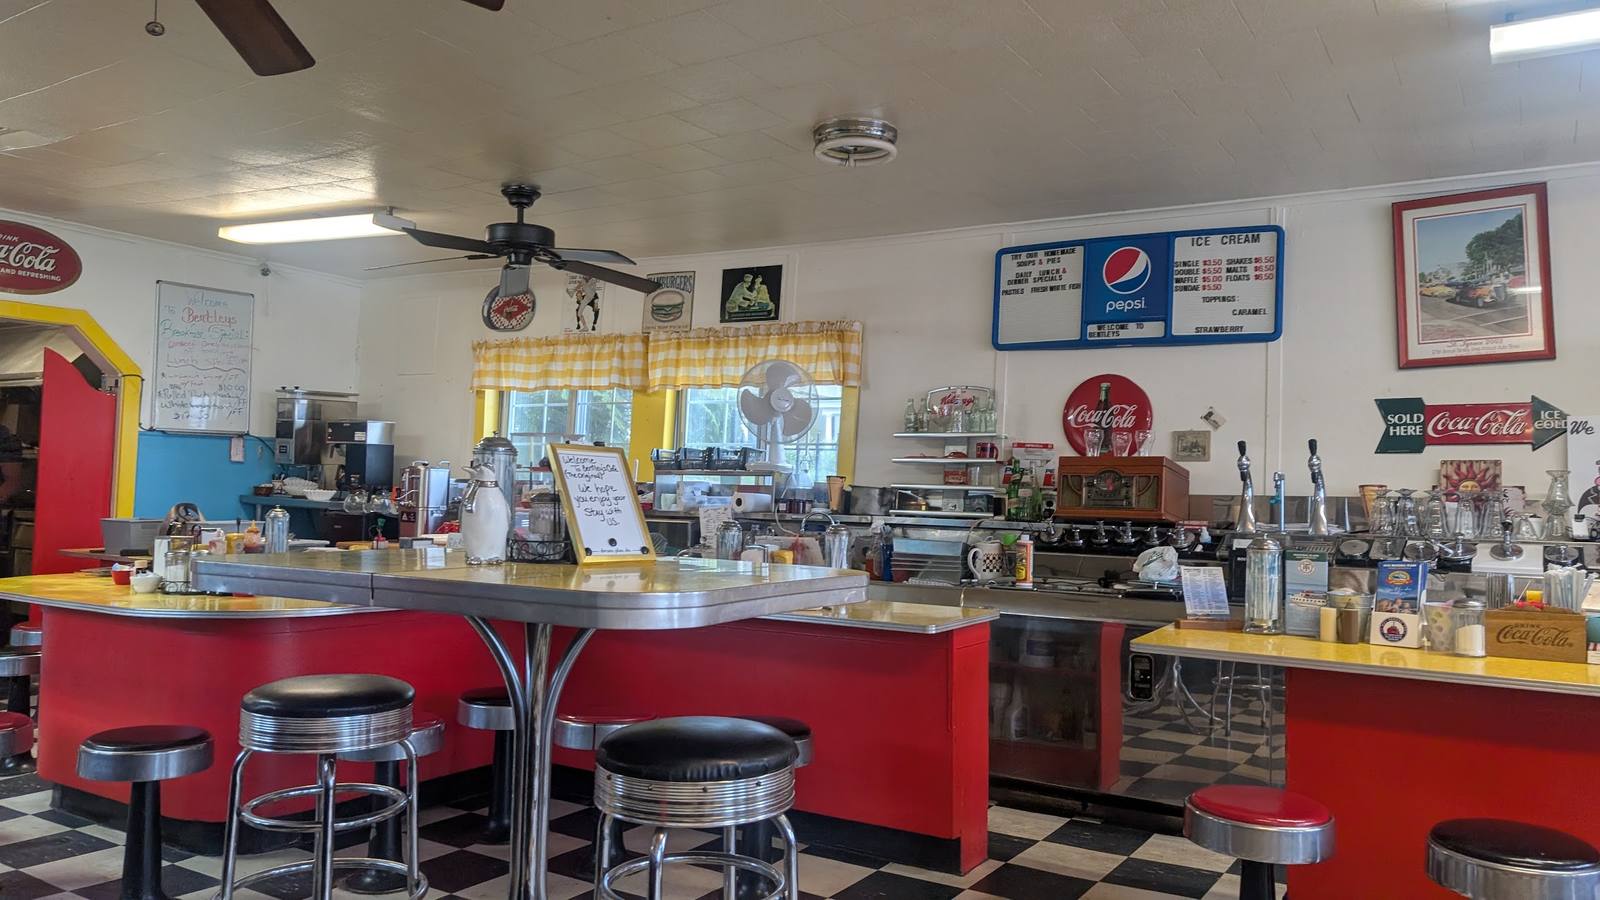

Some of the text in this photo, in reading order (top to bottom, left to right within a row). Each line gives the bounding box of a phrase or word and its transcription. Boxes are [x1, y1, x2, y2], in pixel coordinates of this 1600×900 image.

[1191, 233, 1261, 247] ICE CREAM
[1044, 248, 1076, 257] HOMEMADE
[1016, 259, 1036, 267] SOUPS
[1174, 260, 1200, 268] SINGLE
[1225, 256, 1275, 265] SHAKES $6.50
[0, 267, 61, 282] AND REFRESHING
[1015, 271, 1032, 279] DAILY
[1039, 268, 1060, 276] LUNCH
[1225, 264, 1274, 274] MALTS $6.50
[1007, 275, 1063, 286] DINNER SPECIALS
[1225, 274, 1251, 282] FLOATS
[1106, 297, 1145, 313] pepsi
[1232, 308, 1268, 316] CARAMEL
[1097, 323, 1129, 331] WELCOME
[1195, 326, 1244, 334] STRAWBERRY
[1088, 330, 1120, 338] BENTLEYS
[1069, 404, 1138, 428] Coca-Cola
[1387, 413, 1424, 424] SOLD
[1540, 410, 1561, 420] ICE
[1427, 408, 1528, 438] Coca-Cola
[1570, 420, 1595, 435] We
[1389, 425, 1423, 436] HERE
[562, 456, 597, 465] Welcome
[577, 483, 617, 496] We hope
[573, 495, 588, 508] you
[589, 495, 613, 507] enjoy
[1496, 624, 1572, 647] Coca-Cola
